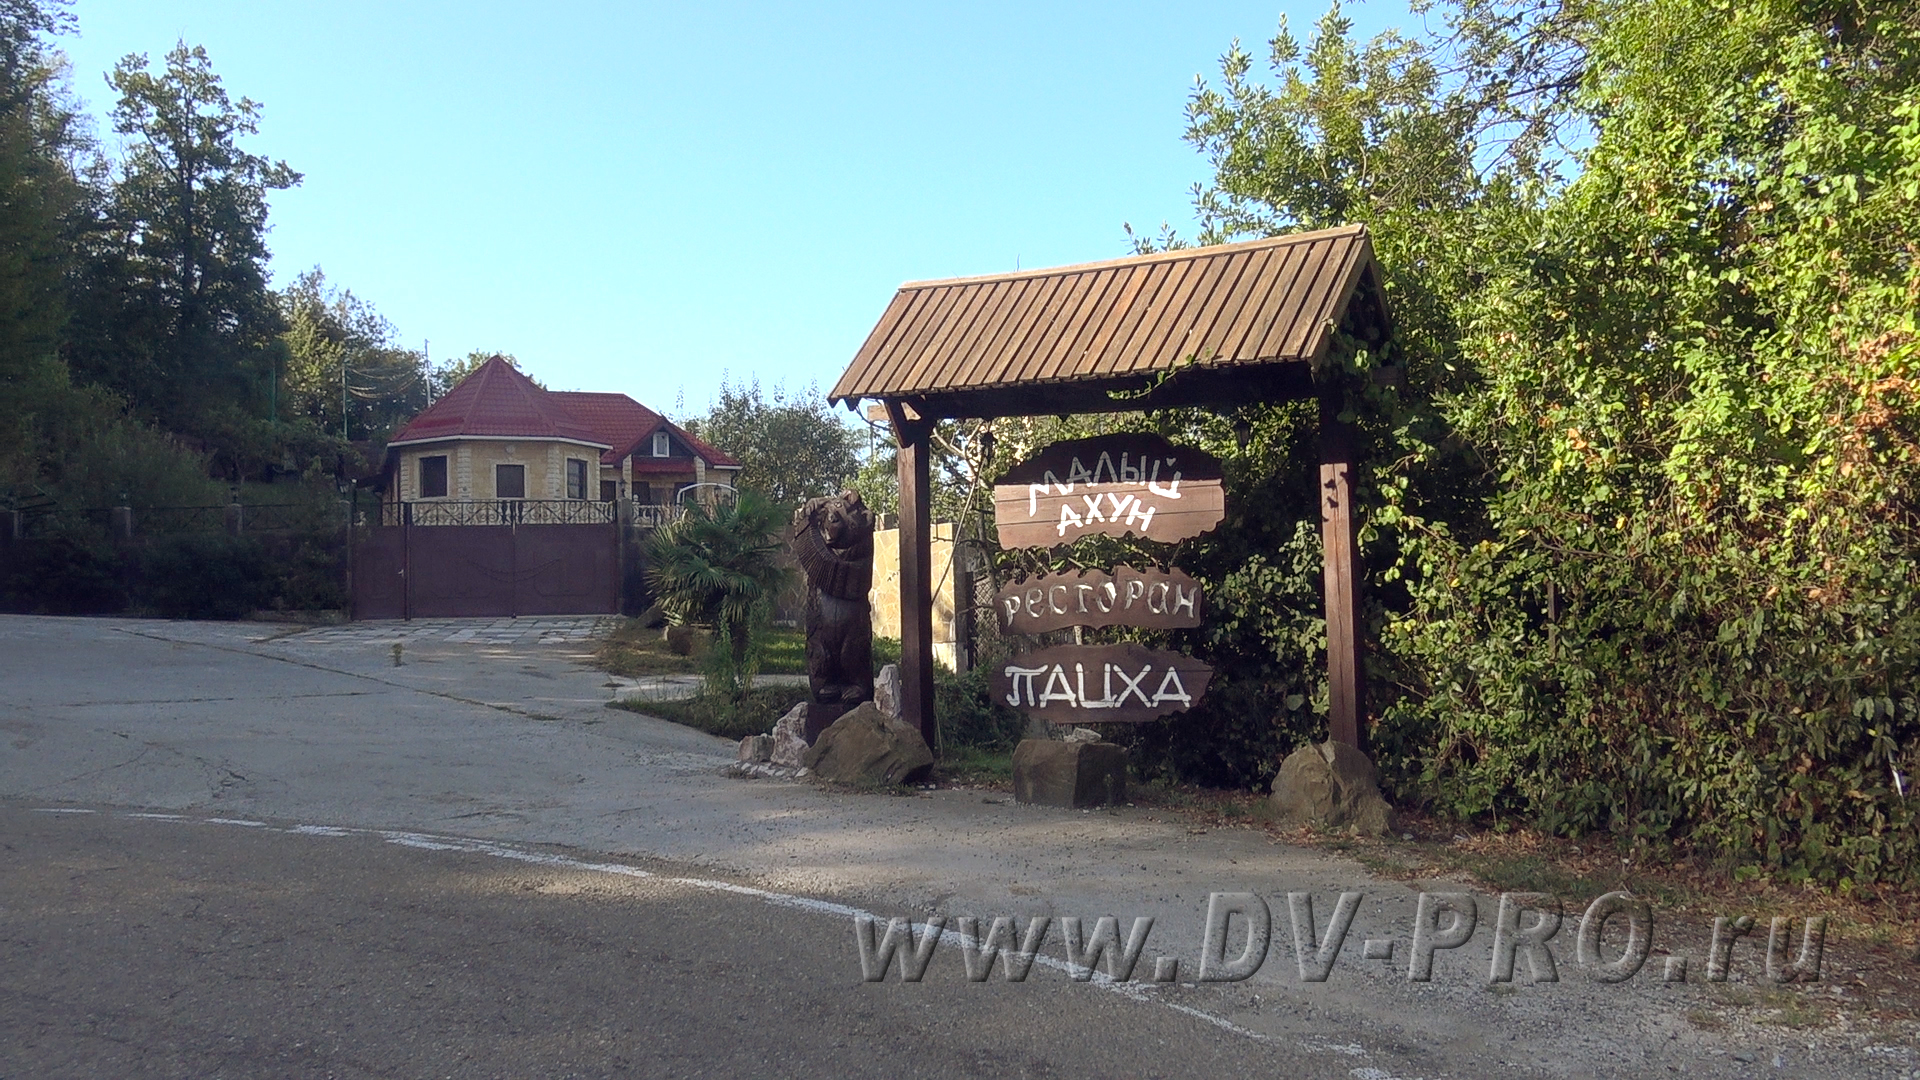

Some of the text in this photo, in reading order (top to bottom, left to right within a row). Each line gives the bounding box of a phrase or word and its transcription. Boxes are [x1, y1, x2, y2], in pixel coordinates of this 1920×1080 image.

[1029, 451, 1182, 518] МАЛЫЙ
[1057, 492, 1156, 537] АХУН
[1004, 662, 1192, 709] ПАЦХА
